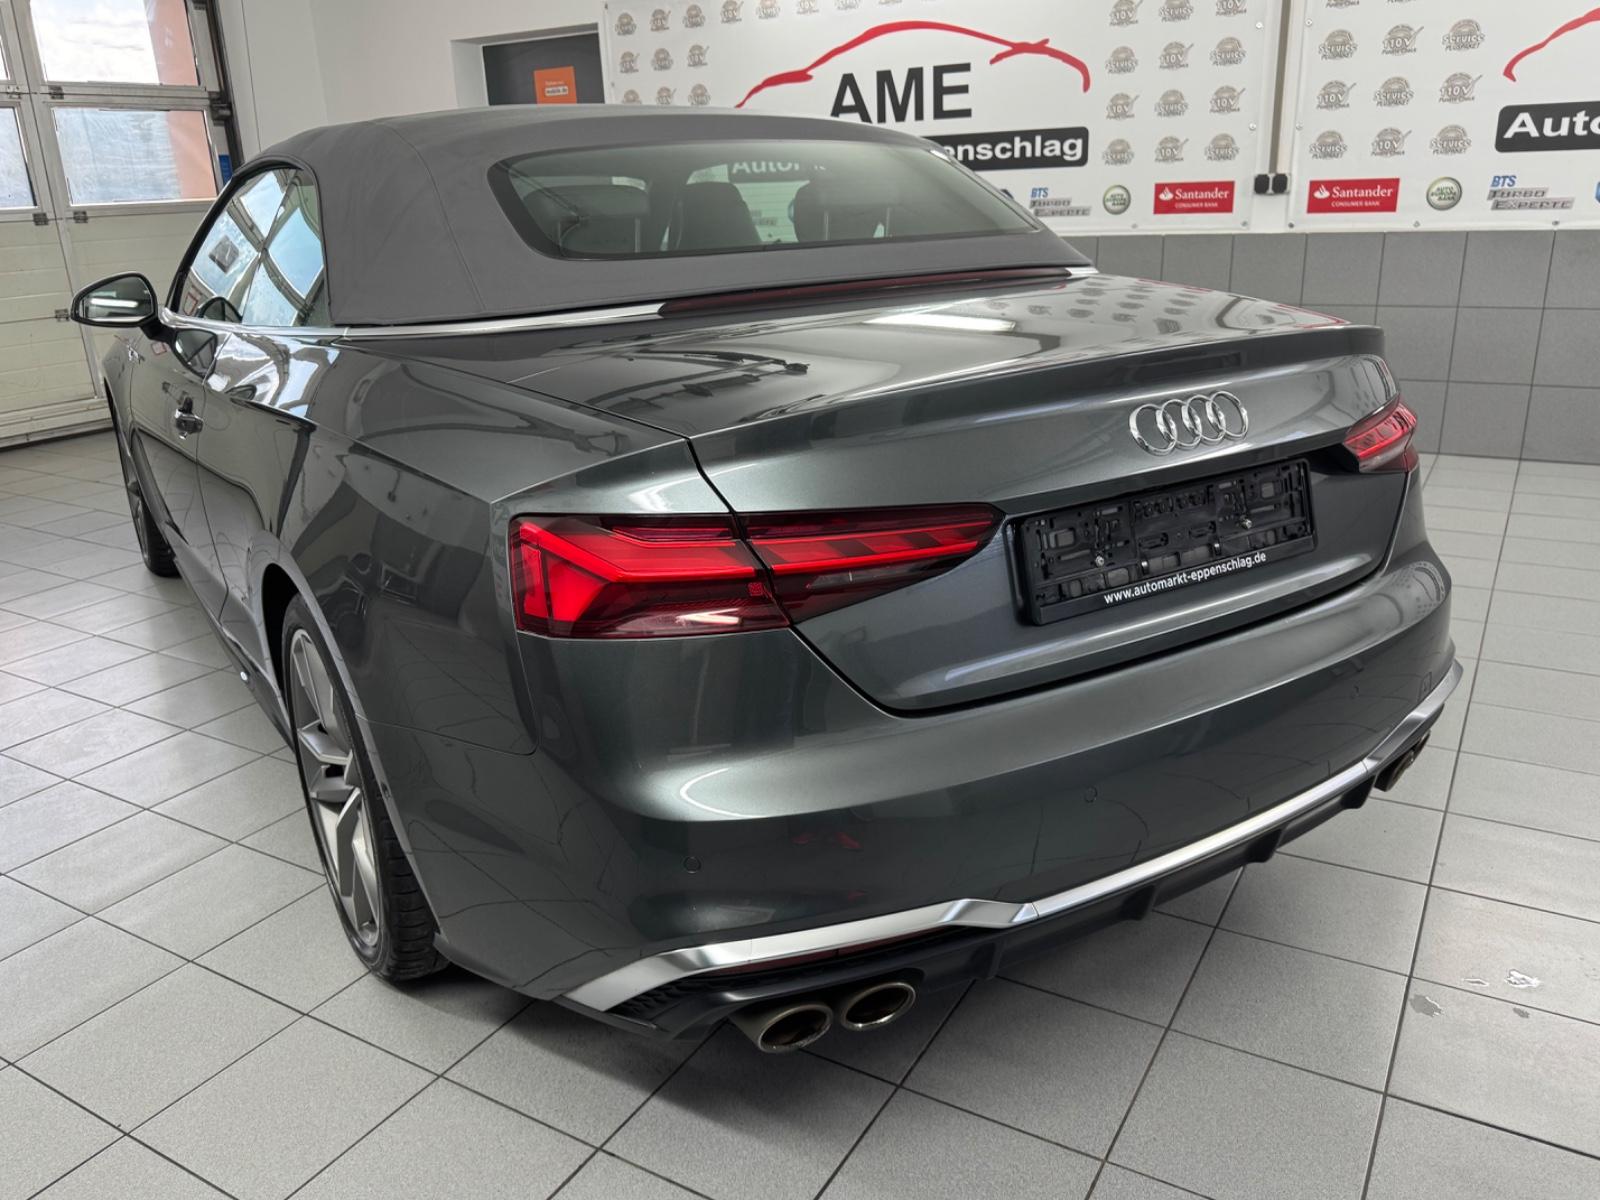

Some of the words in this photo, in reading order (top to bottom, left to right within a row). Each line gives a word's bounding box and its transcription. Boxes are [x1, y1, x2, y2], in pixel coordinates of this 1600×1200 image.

[831, 63, 972, 124] AME
[1490, 175, 1517, 187] BTS
[1031, 187, 1049, 198] BTS
[1175, 187, 1229, 199] Santander
[1332, 184, 1393, 198] Santander
[1104, 551, 1267, 604] www.automarkt-eppenschlag.de
